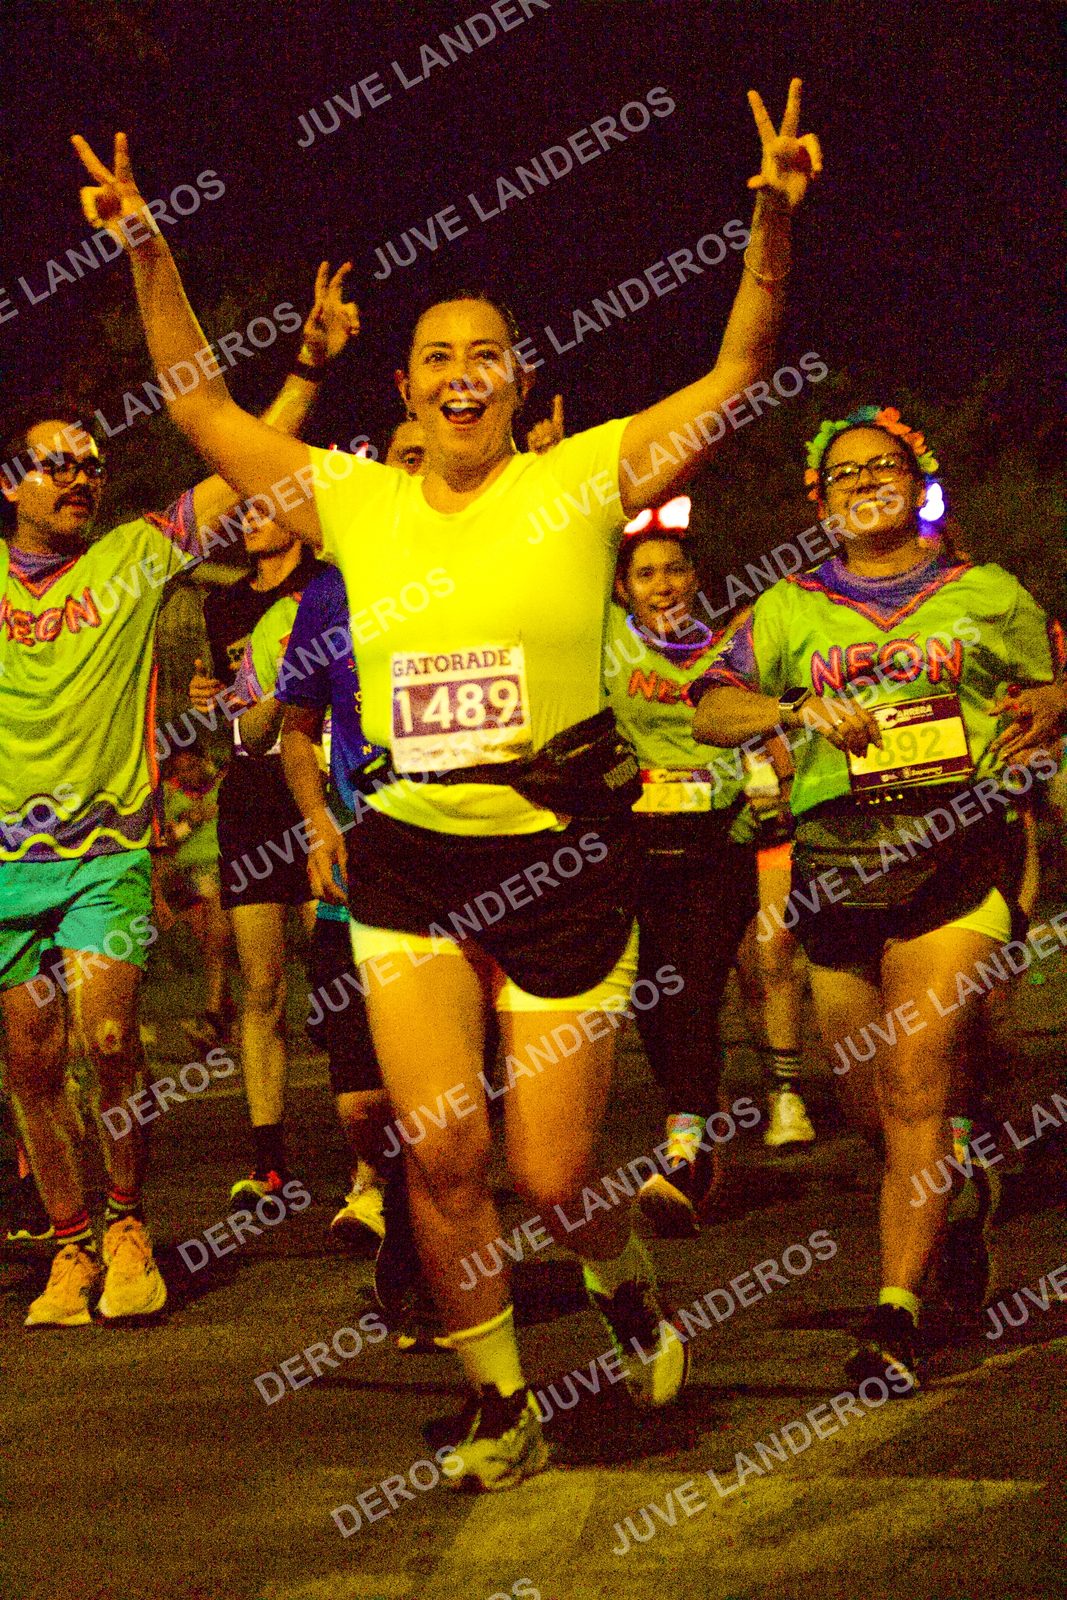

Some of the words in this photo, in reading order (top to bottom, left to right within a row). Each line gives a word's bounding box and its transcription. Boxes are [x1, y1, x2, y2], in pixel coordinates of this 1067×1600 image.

[393, 649, 511, 677] GATORADE
[811, 632, 963, 697] NEON
[395, 680, 519, 734] 1489
[875, 725, 945, 767] 892
